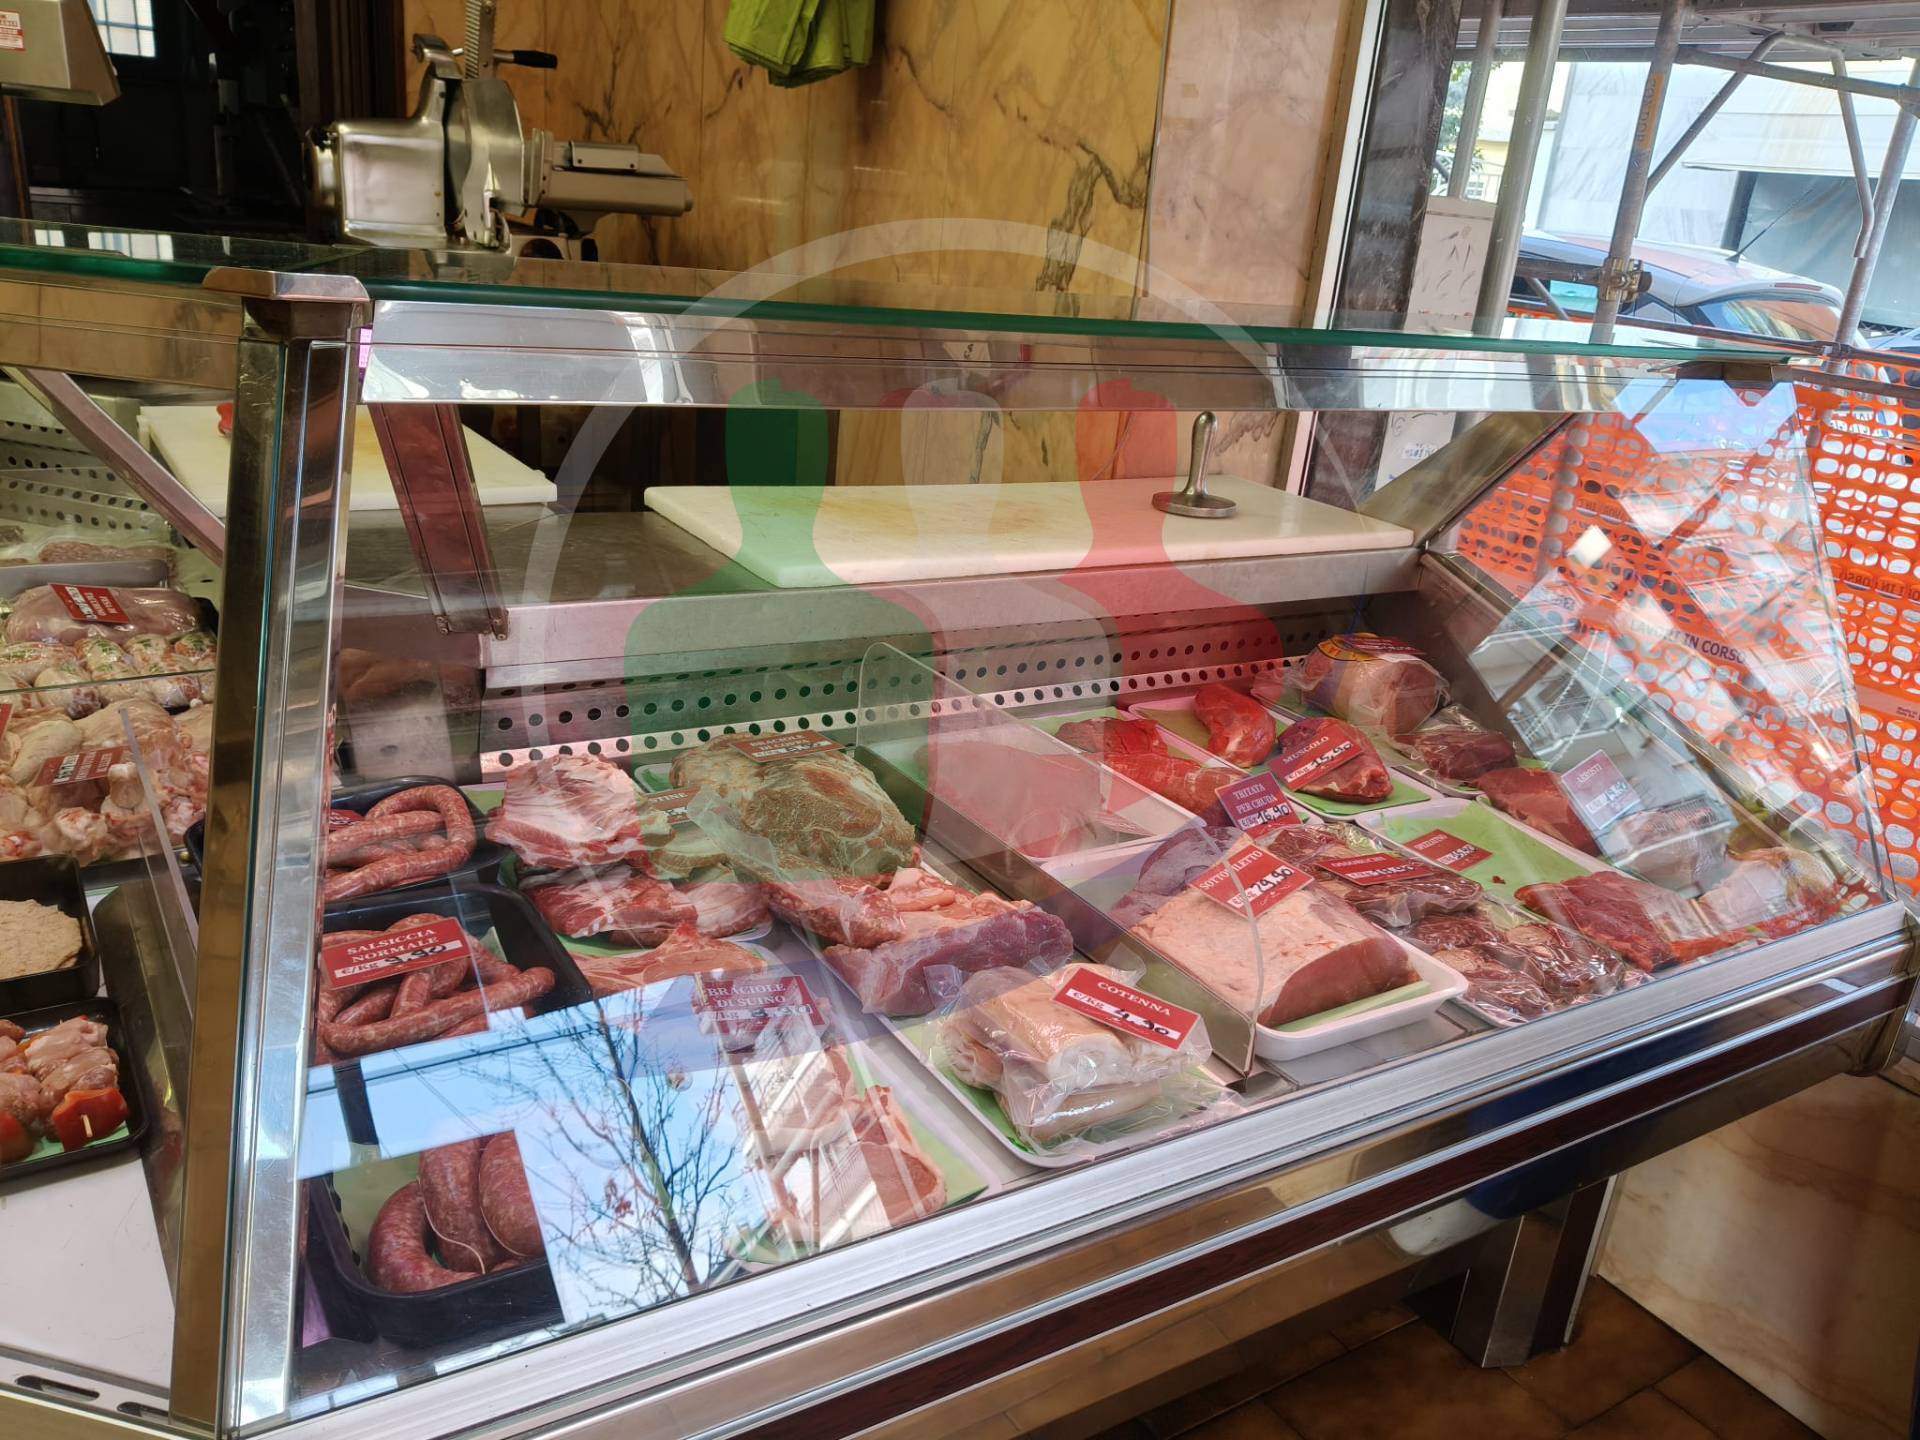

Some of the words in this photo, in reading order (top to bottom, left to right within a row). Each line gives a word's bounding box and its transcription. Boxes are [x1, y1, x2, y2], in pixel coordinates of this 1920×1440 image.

[1684, 632, 1700, 649] IN
[1701, 640, 1746, 664] CORSO
[1282, 736, 1329, 764] MUSCOLO
[647, 792, 689, 803] STINE
[347, 928, 437, 956] SALSICCIA
[351, 936, 440, 964] NORMALE
[708, 983, 787, 997] BRACIOLE
[717, 999, 733, 1009] DI
[737, 994, 786, 1007] SUINO
[1097, 981, 1171, 1017] COTENNA
